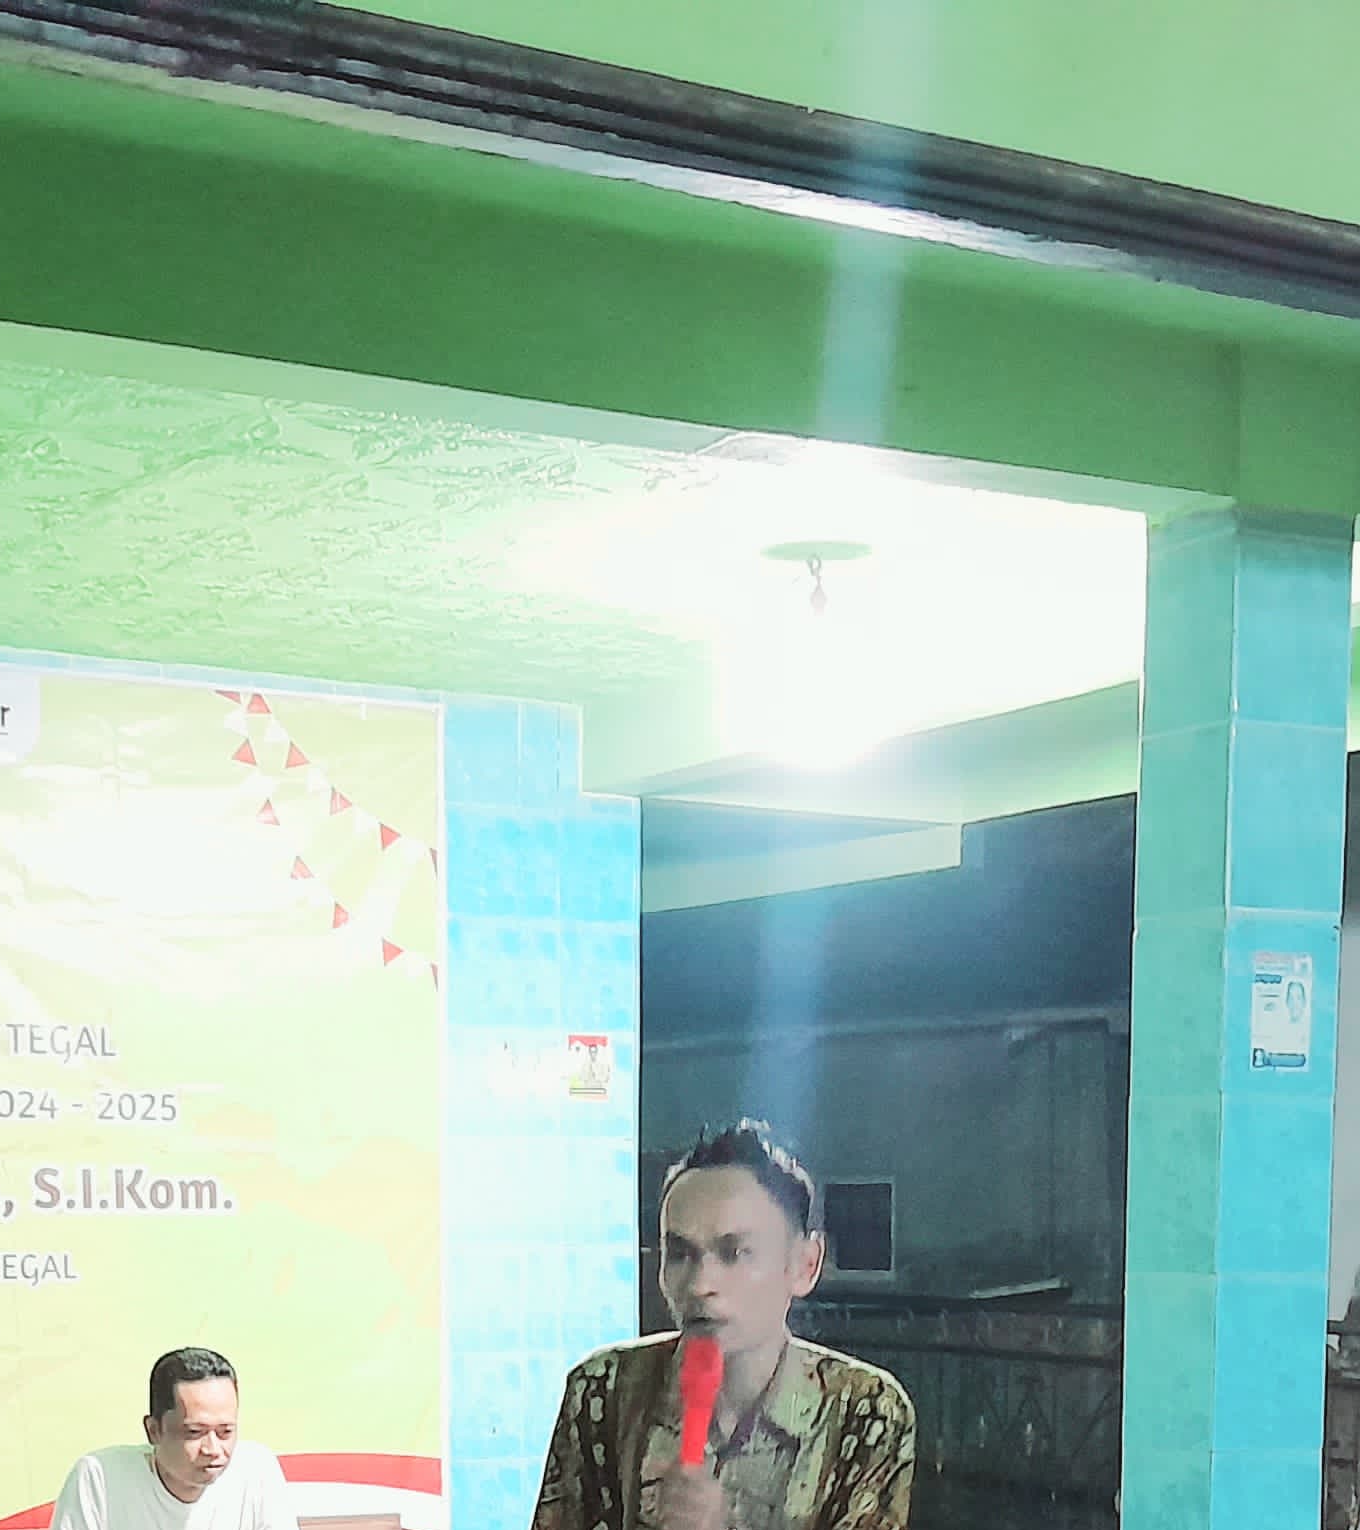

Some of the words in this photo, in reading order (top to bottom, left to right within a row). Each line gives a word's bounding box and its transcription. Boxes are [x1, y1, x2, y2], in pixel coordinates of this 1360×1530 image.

[6, 1023, 116, 1062] TEGAL
[97, 1091, 178, 1121] 2025
[33, 1167, 234, 1210] S.I.Kom.
